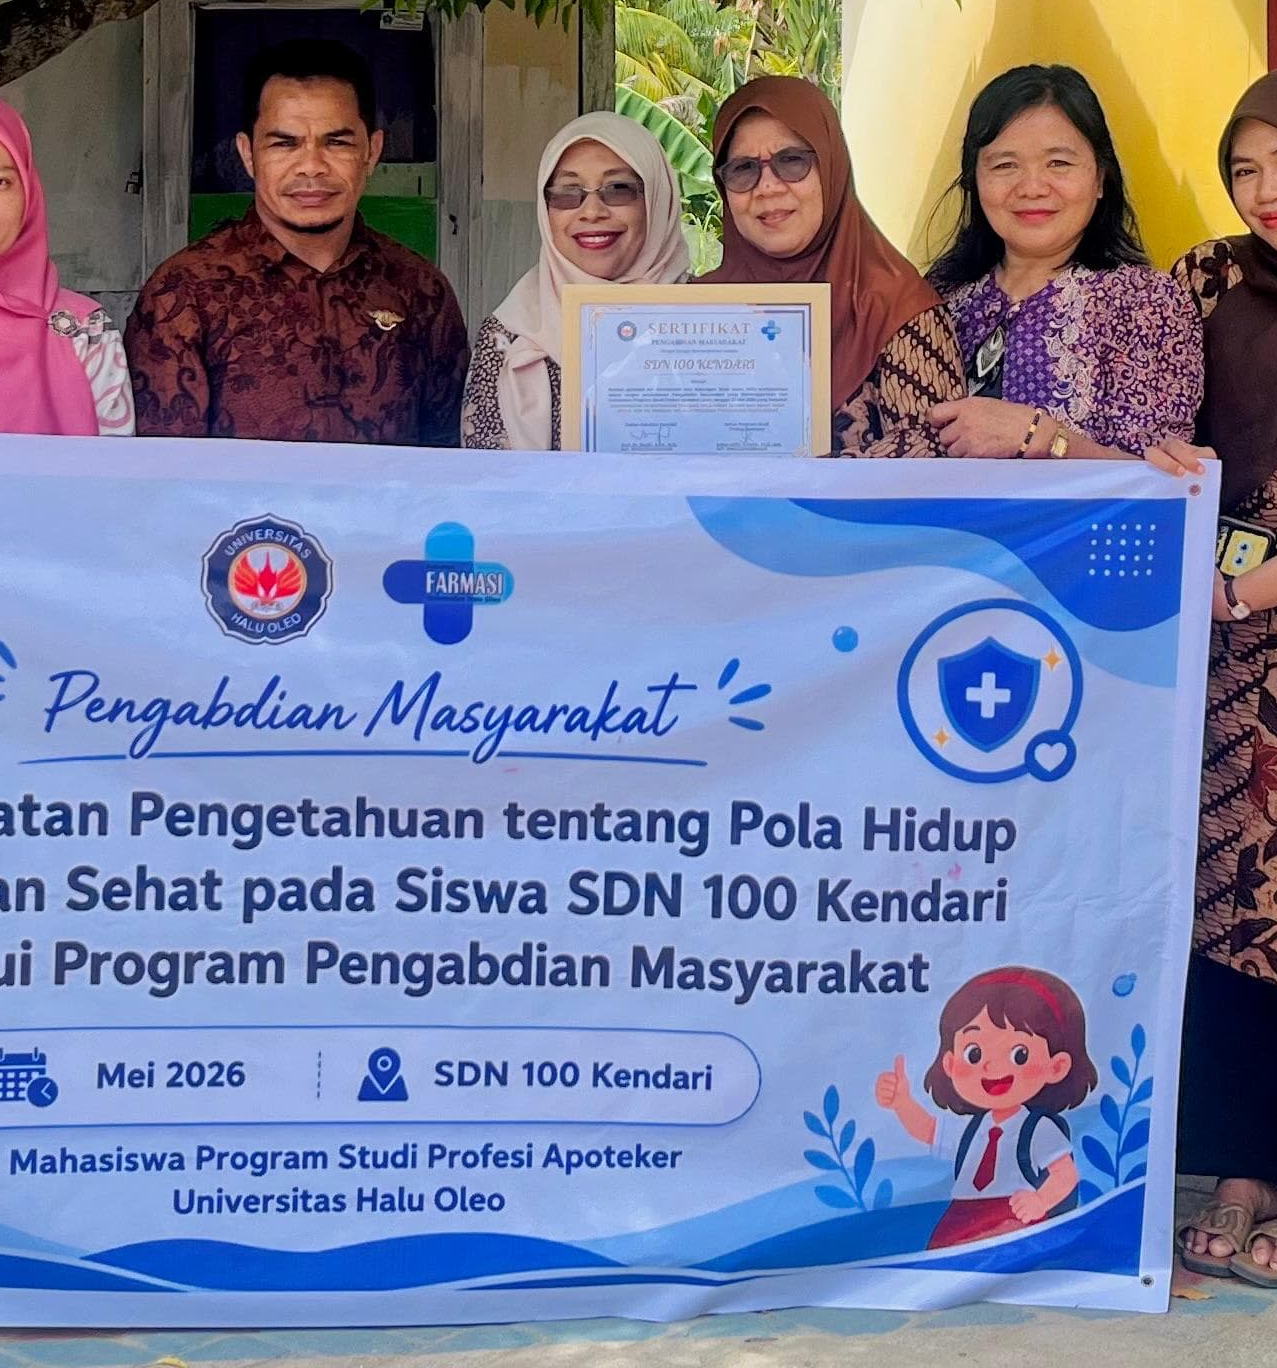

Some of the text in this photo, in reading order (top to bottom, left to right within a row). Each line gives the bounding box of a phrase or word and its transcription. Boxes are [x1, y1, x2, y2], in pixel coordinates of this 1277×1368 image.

[648, 320, 751, 335] SERTIFIKAT
[644, 358, 756, 370] SDN 100 KENDARI
[224, 528, 312, 559] UNIVERSITAS
[425, 570, 504, 595] FARMASI
[230, 612, 302, 634] HALU OLEO
[43, 668, 698, 764] Pengabdian Masyarakat
[130, 791, 484, 851] Pengetahuan
[502, 802, 710, 858] tentang
[730, 800, 843, 850] Pola
[863, 806, 1017, 864] Hidup
[65, 864, 223, 912] Sehat
[242, 865, 375, 924] pada
[395, 866, 548, 915] Siswa
[567, 870, 683, 918] SDN
[703, 874, 798, 921] 100
[817, 877, 1008, 923] Kendari
[54, 941, 285, 999] Program
[306, 940, 610, 998] Pengabdian
[630, 945, 930, 1006] Masyarakat
[97, 1060, 246, 1090] Mei 2026
[434, 1060, 713, 1091] SDN 100 Kendari
[10, 1142, 683, 1178] Mahasiswa Program Studi Profesi Apoteker
[173, 1185, 506, 1215] Universitas Halu Oleo
